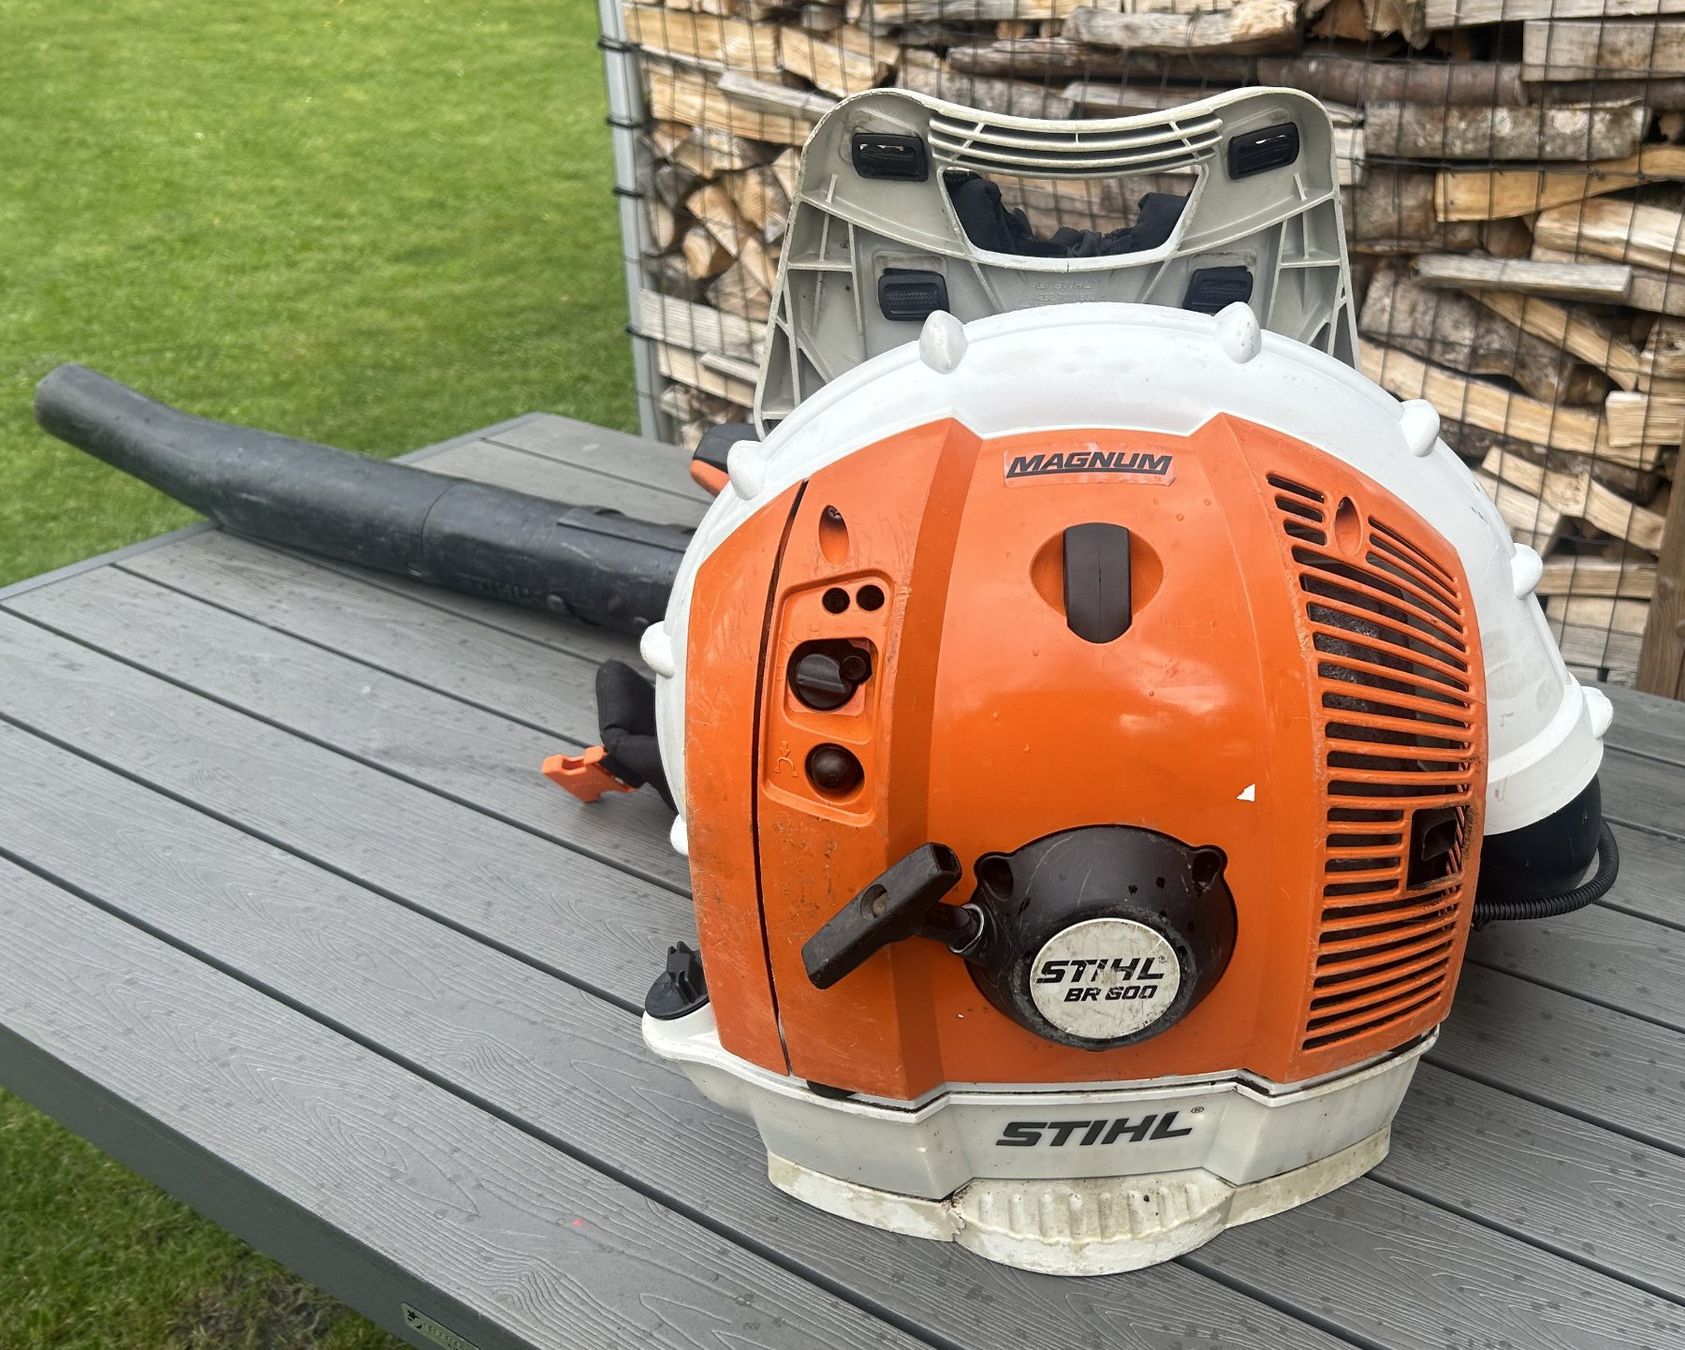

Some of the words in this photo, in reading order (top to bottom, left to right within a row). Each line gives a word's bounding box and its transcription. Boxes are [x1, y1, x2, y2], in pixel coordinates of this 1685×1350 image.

[1006, 451, 1173, 478] MAGNUM
[1036, 957, 1165, 984] STIHL
[1064, 987, 1102, 1002] BR
[1105, 985, 1158, 1000] 600
[996, 1111, 1193, 1147] STIHL
